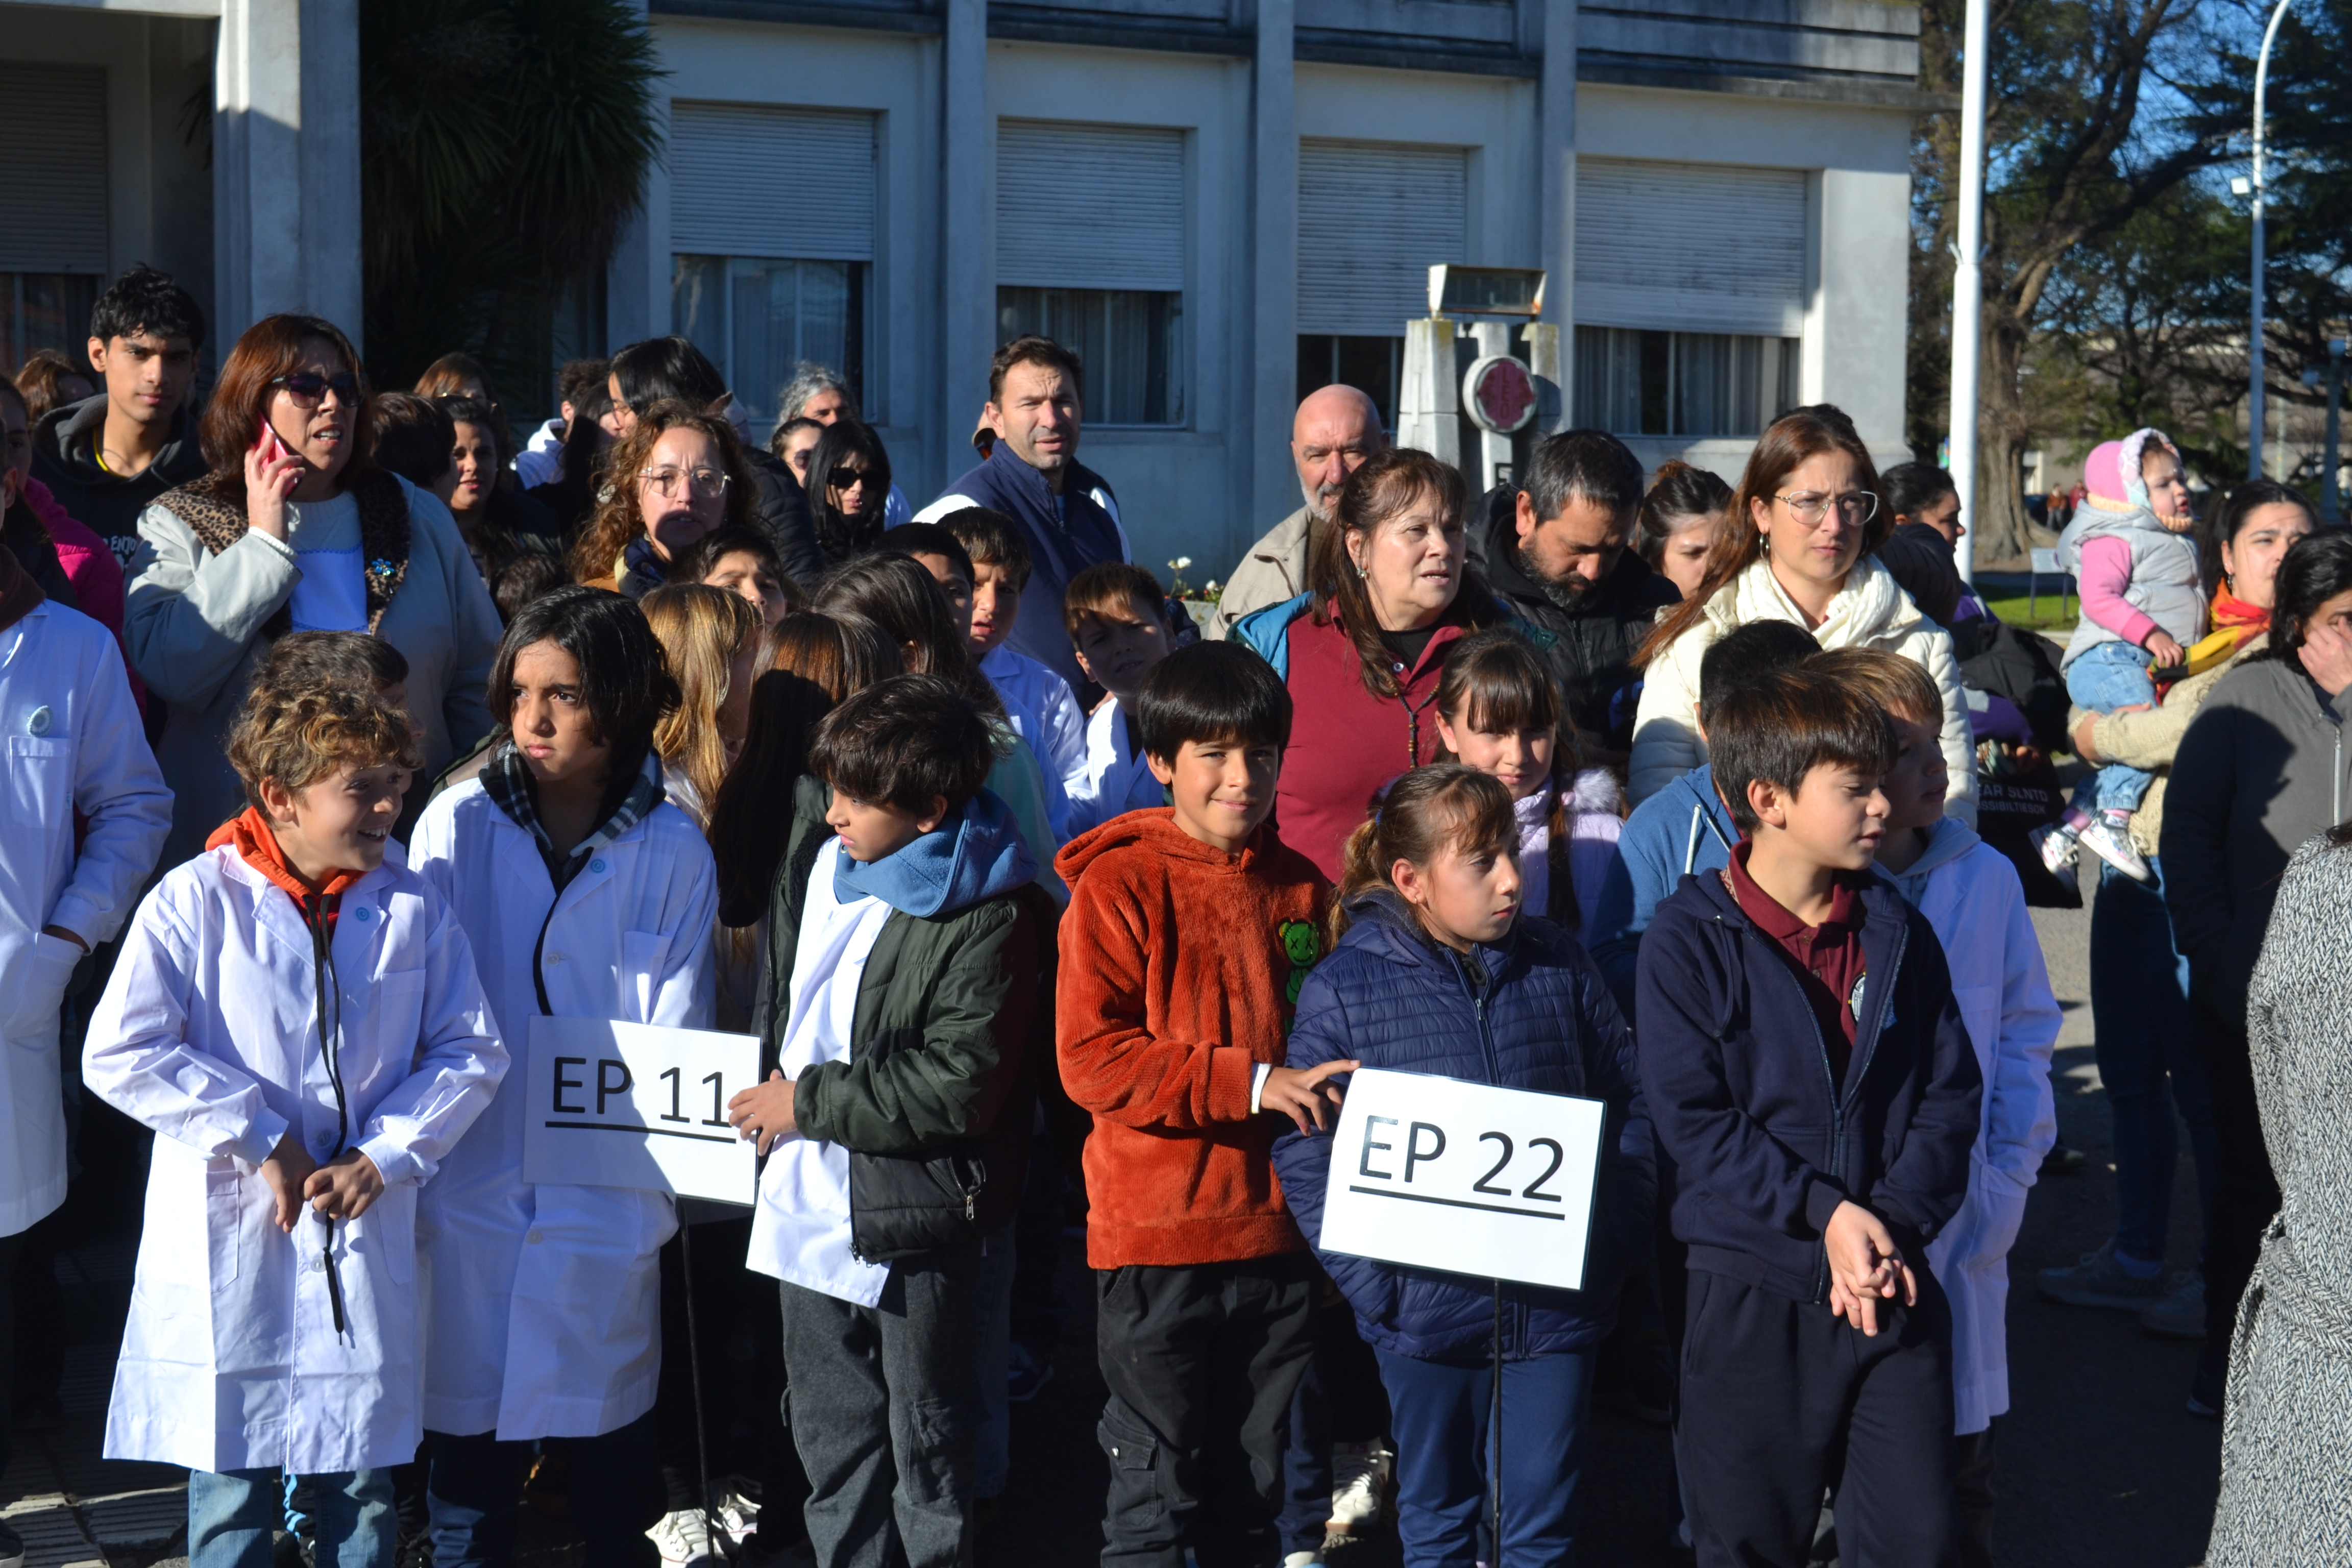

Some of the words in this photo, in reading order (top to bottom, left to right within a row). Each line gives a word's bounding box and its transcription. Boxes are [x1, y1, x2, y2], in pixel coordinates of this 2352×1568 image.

[553, 1056, 632, 1115] EP
[660, 1067, 732, 1128] 11
[1359, 1115, 1447, 1183] EP
[1473, 1131, 1564, 1202] 22
